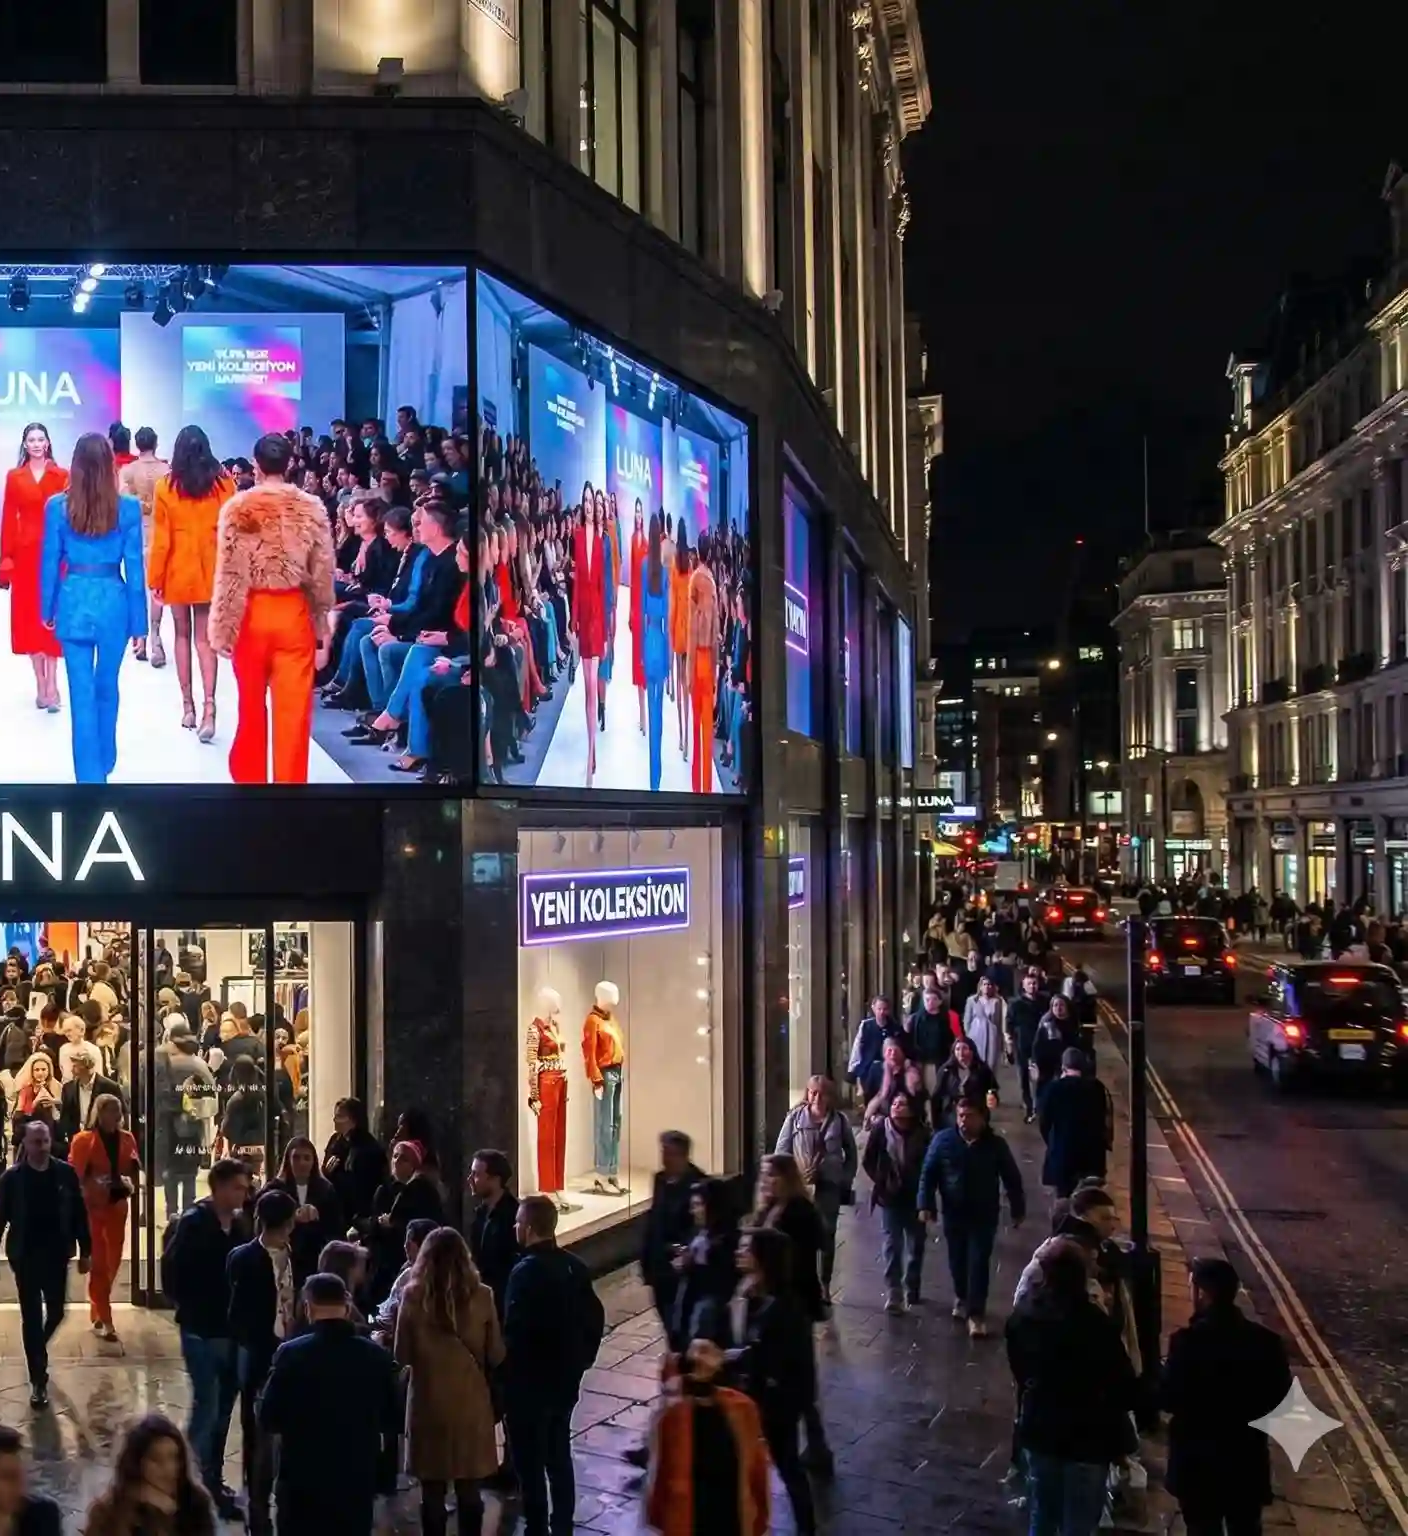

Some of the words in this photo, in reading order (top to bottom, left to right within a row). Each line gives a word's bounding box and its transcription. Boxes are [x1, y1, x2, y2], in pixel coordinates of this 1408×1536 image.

[616, 444, 652, 489] LUNA
[917, 796, 954, 806] LUNA
[530, 881, 576, 927] YENİ
[580, 876, 685, 922] KOLEKSİYON
